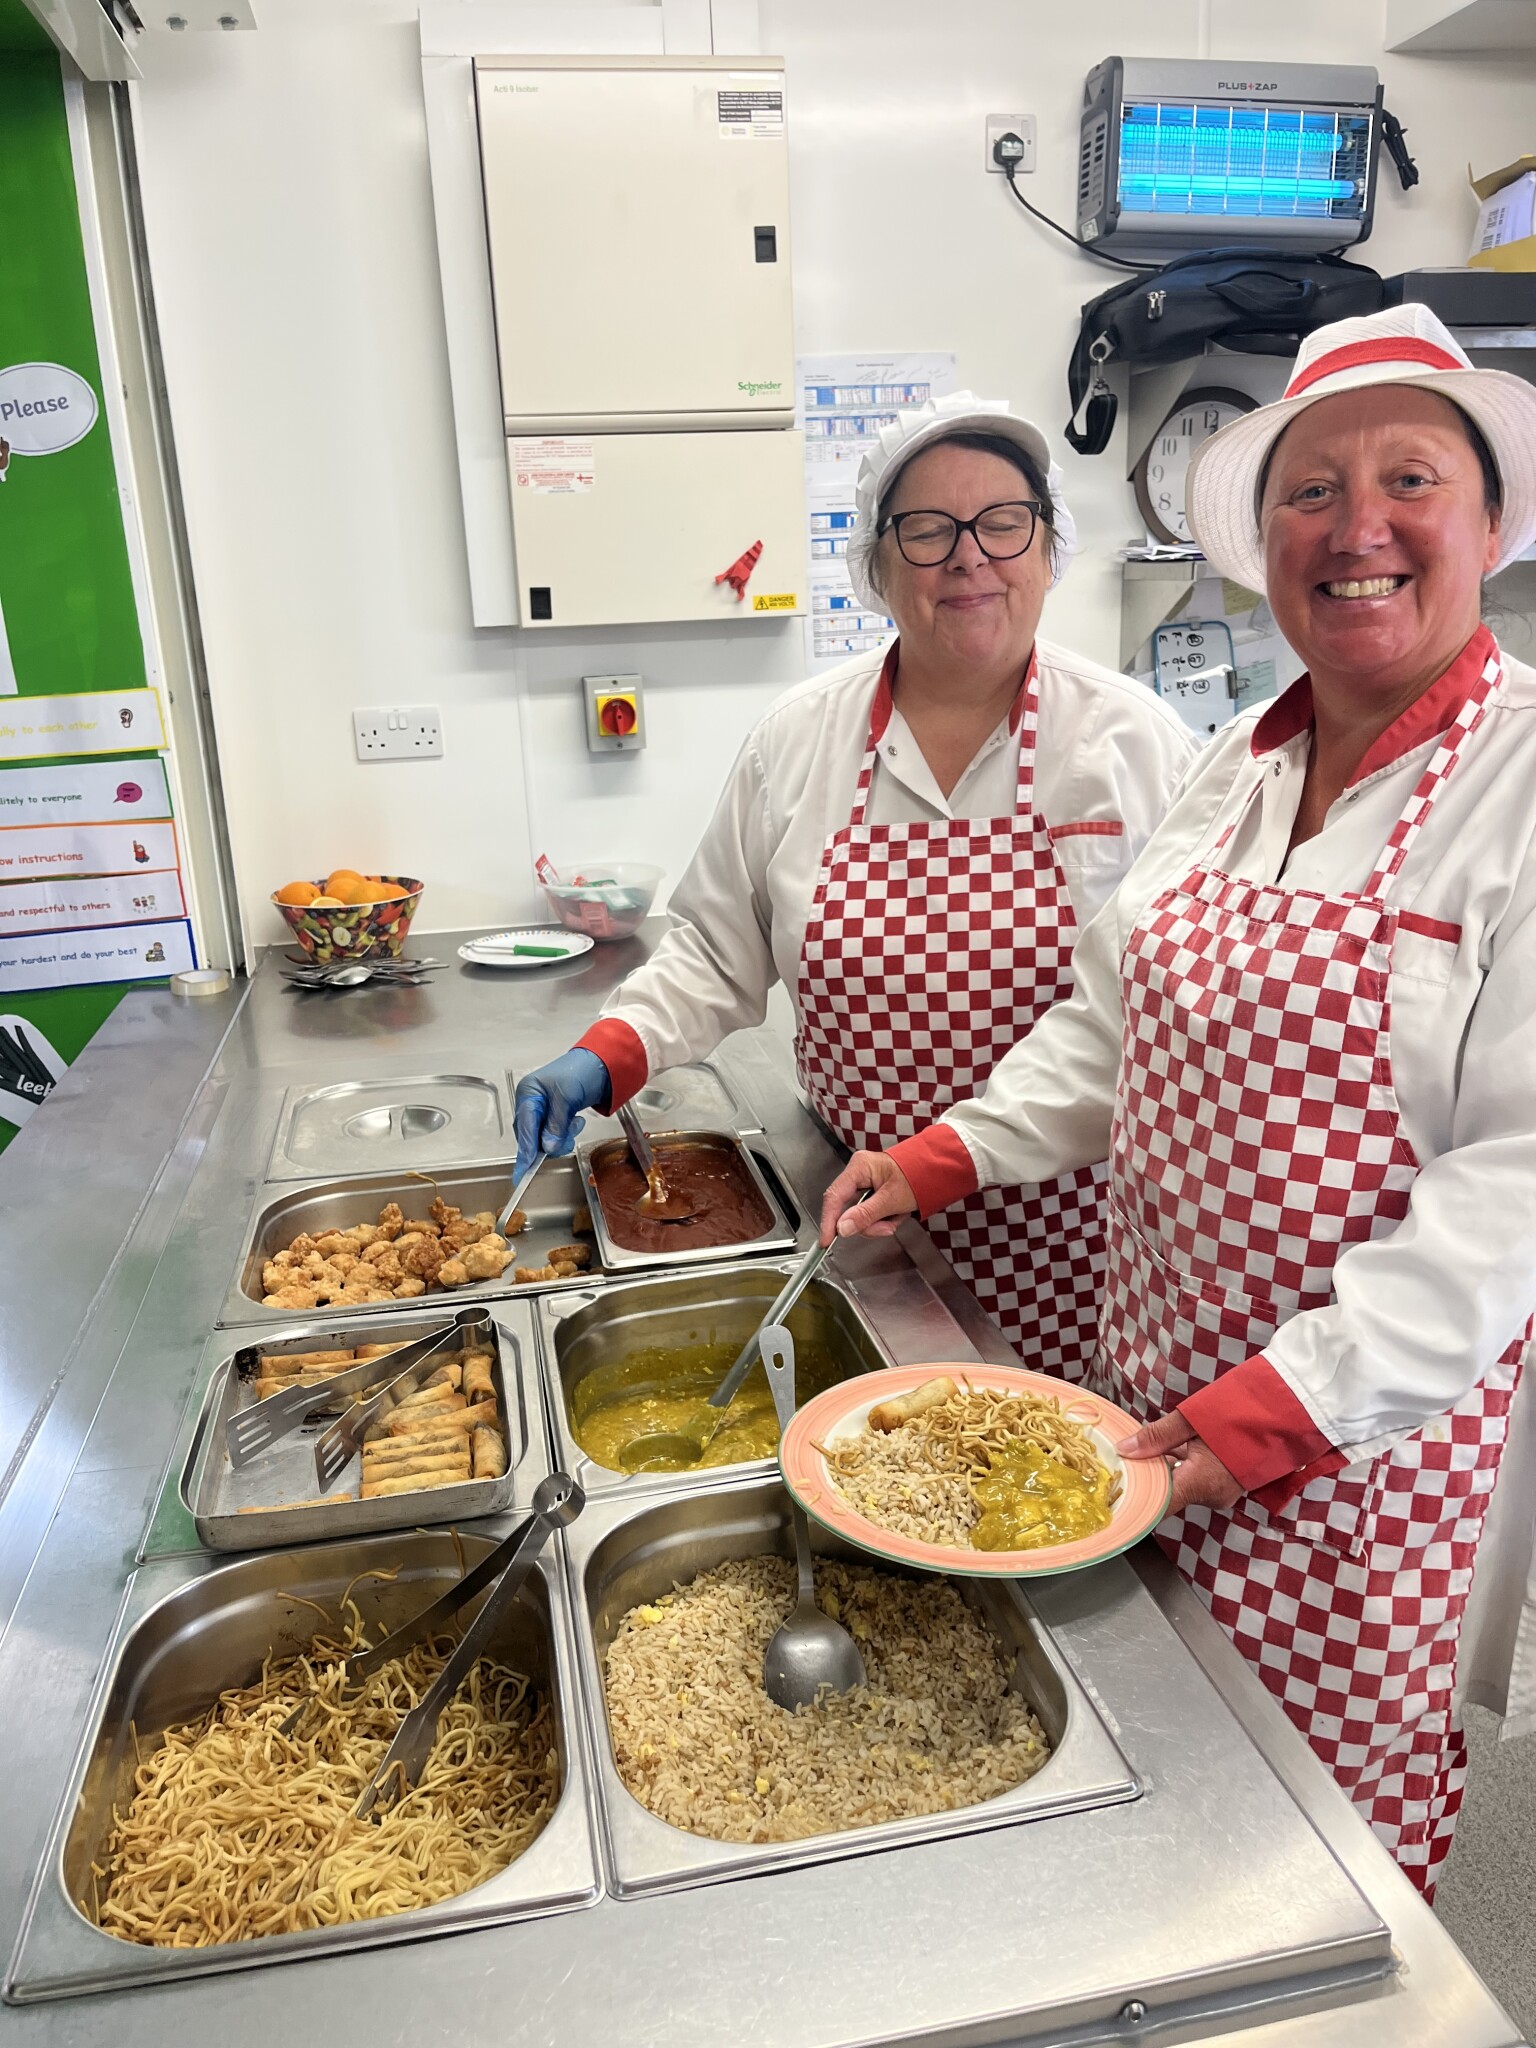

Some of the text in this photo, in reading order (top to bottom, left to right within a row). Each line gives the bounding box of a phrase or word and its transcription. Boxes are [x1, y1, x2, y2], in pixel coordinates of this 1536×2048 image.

[737, 380, 783, 397] Schneider
[0, 396, 70, 421] Please
[1182, 418, 1193, 436] 11
[1162, 438, 1177, 456] 10
[1152, 465, 1165, 483] 9
[1158, 492, 1172, 511] 8
[22, 725, 33, 735] to
[68, 720, 97, 731] other
[42, 794, 82, 804] everyone
[18, 852, 84, 864] instructions
[0, 901, 110, 918] and respectful to others
[21, 955, 57, 965] hardest
[61, 952, 77, 961] and
[80, 951, 91, 959] do
[94, 950, 114, 960] your
[117, 947, 137, 956] best
